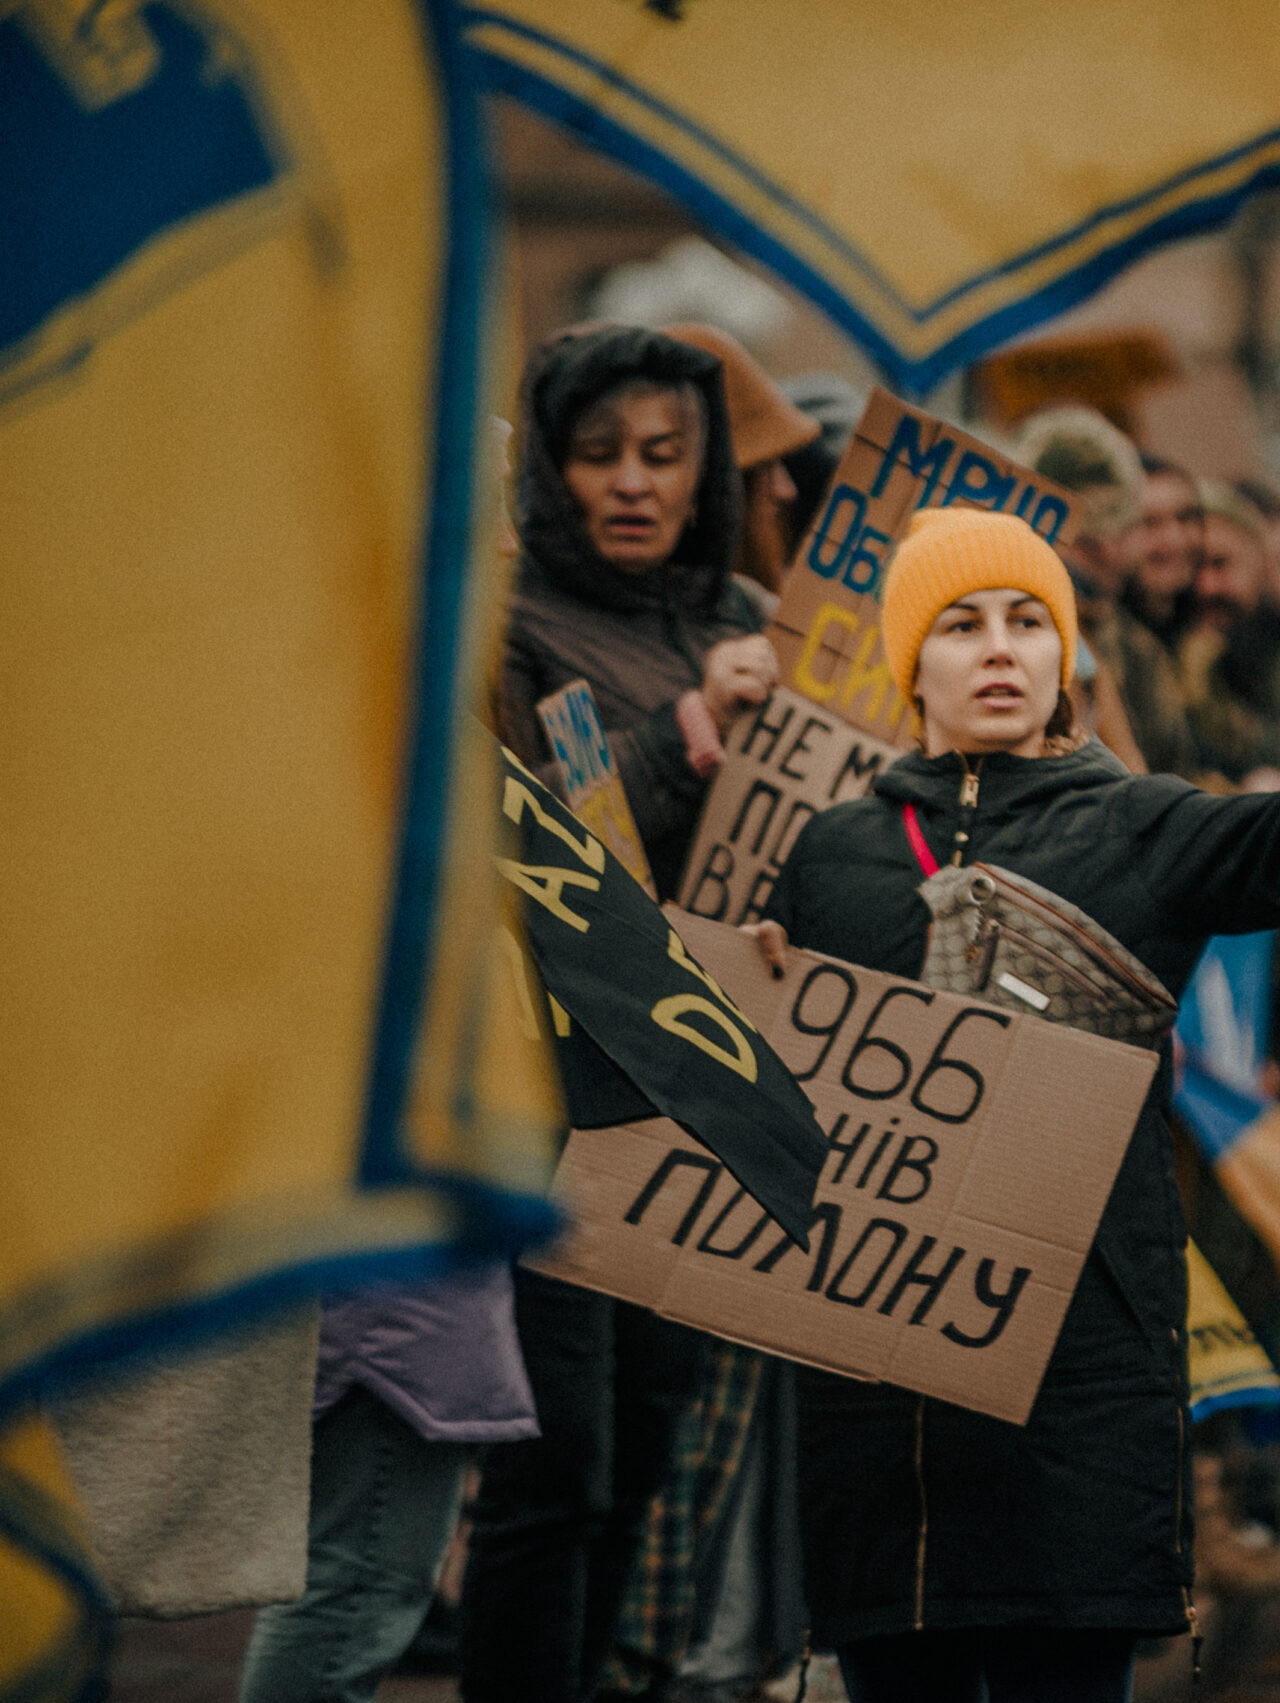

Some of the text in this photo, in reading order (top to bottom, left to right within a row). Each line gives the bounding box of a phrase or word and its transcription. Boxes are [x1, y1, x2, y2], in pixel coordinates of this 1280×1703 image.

[740, 692, 833, 781] НЕ
[790, 962, 1012, 1126] 966
[622, 1147, 1034, 1350] ПОЛОНУ
